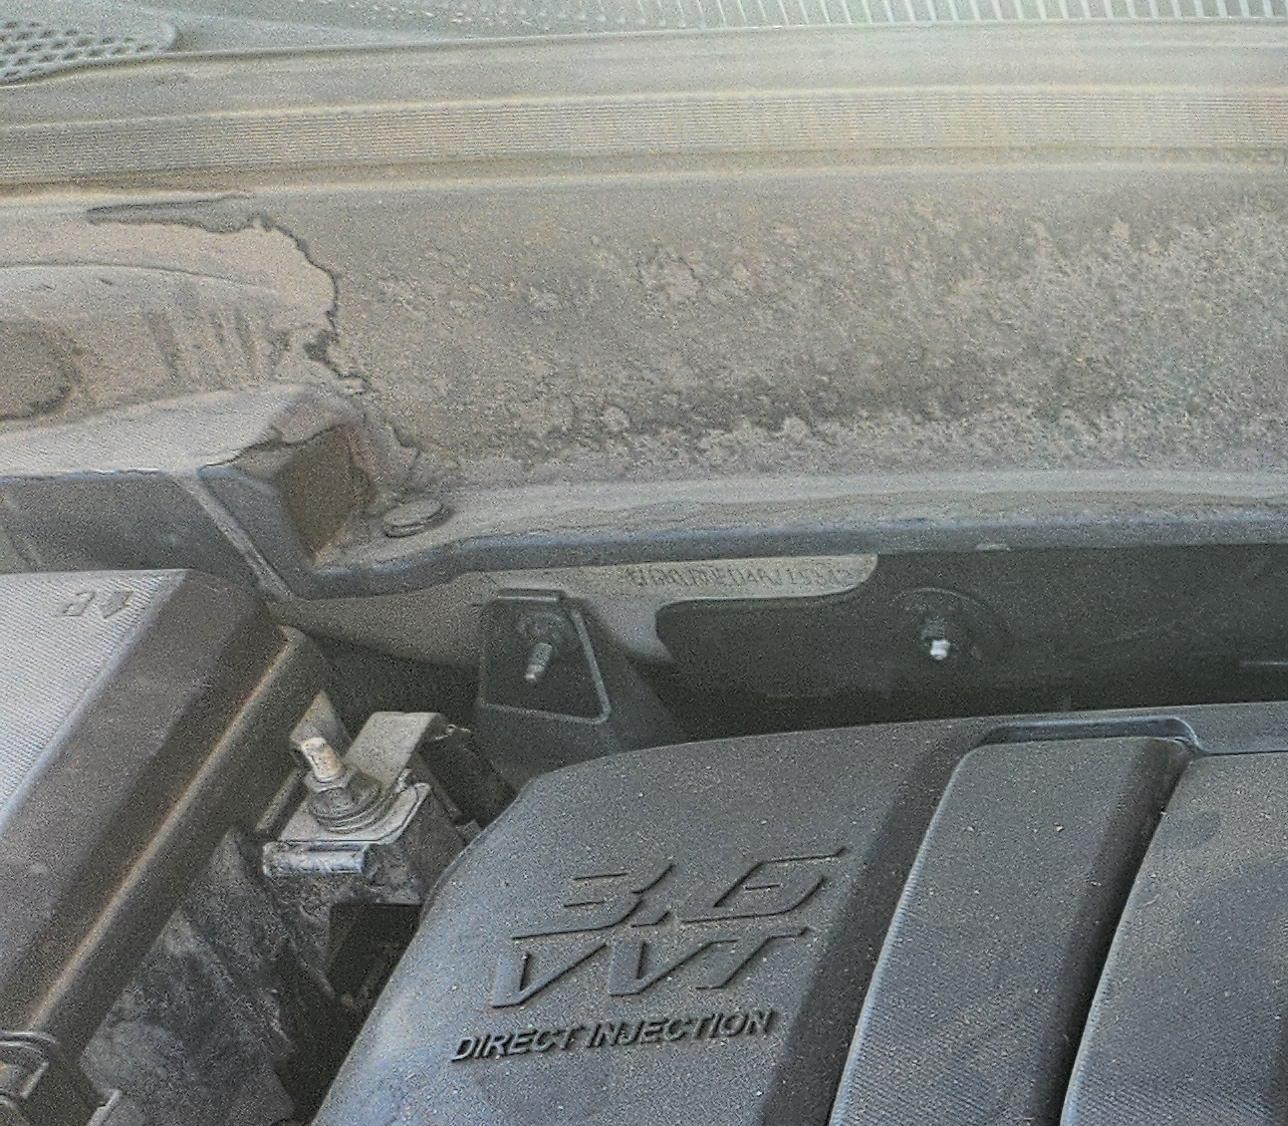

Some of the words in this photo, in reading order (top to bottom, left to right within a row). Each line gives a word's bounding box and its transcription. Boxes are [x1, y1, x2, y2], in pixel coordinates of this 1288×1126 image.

[512, 846, 847, 942] 3.6
[489, 925, 812, 1010] VVT
[450, 1025, 582, 1064] DIRECT
[587, 1008, 777, 1049] INJECTION
